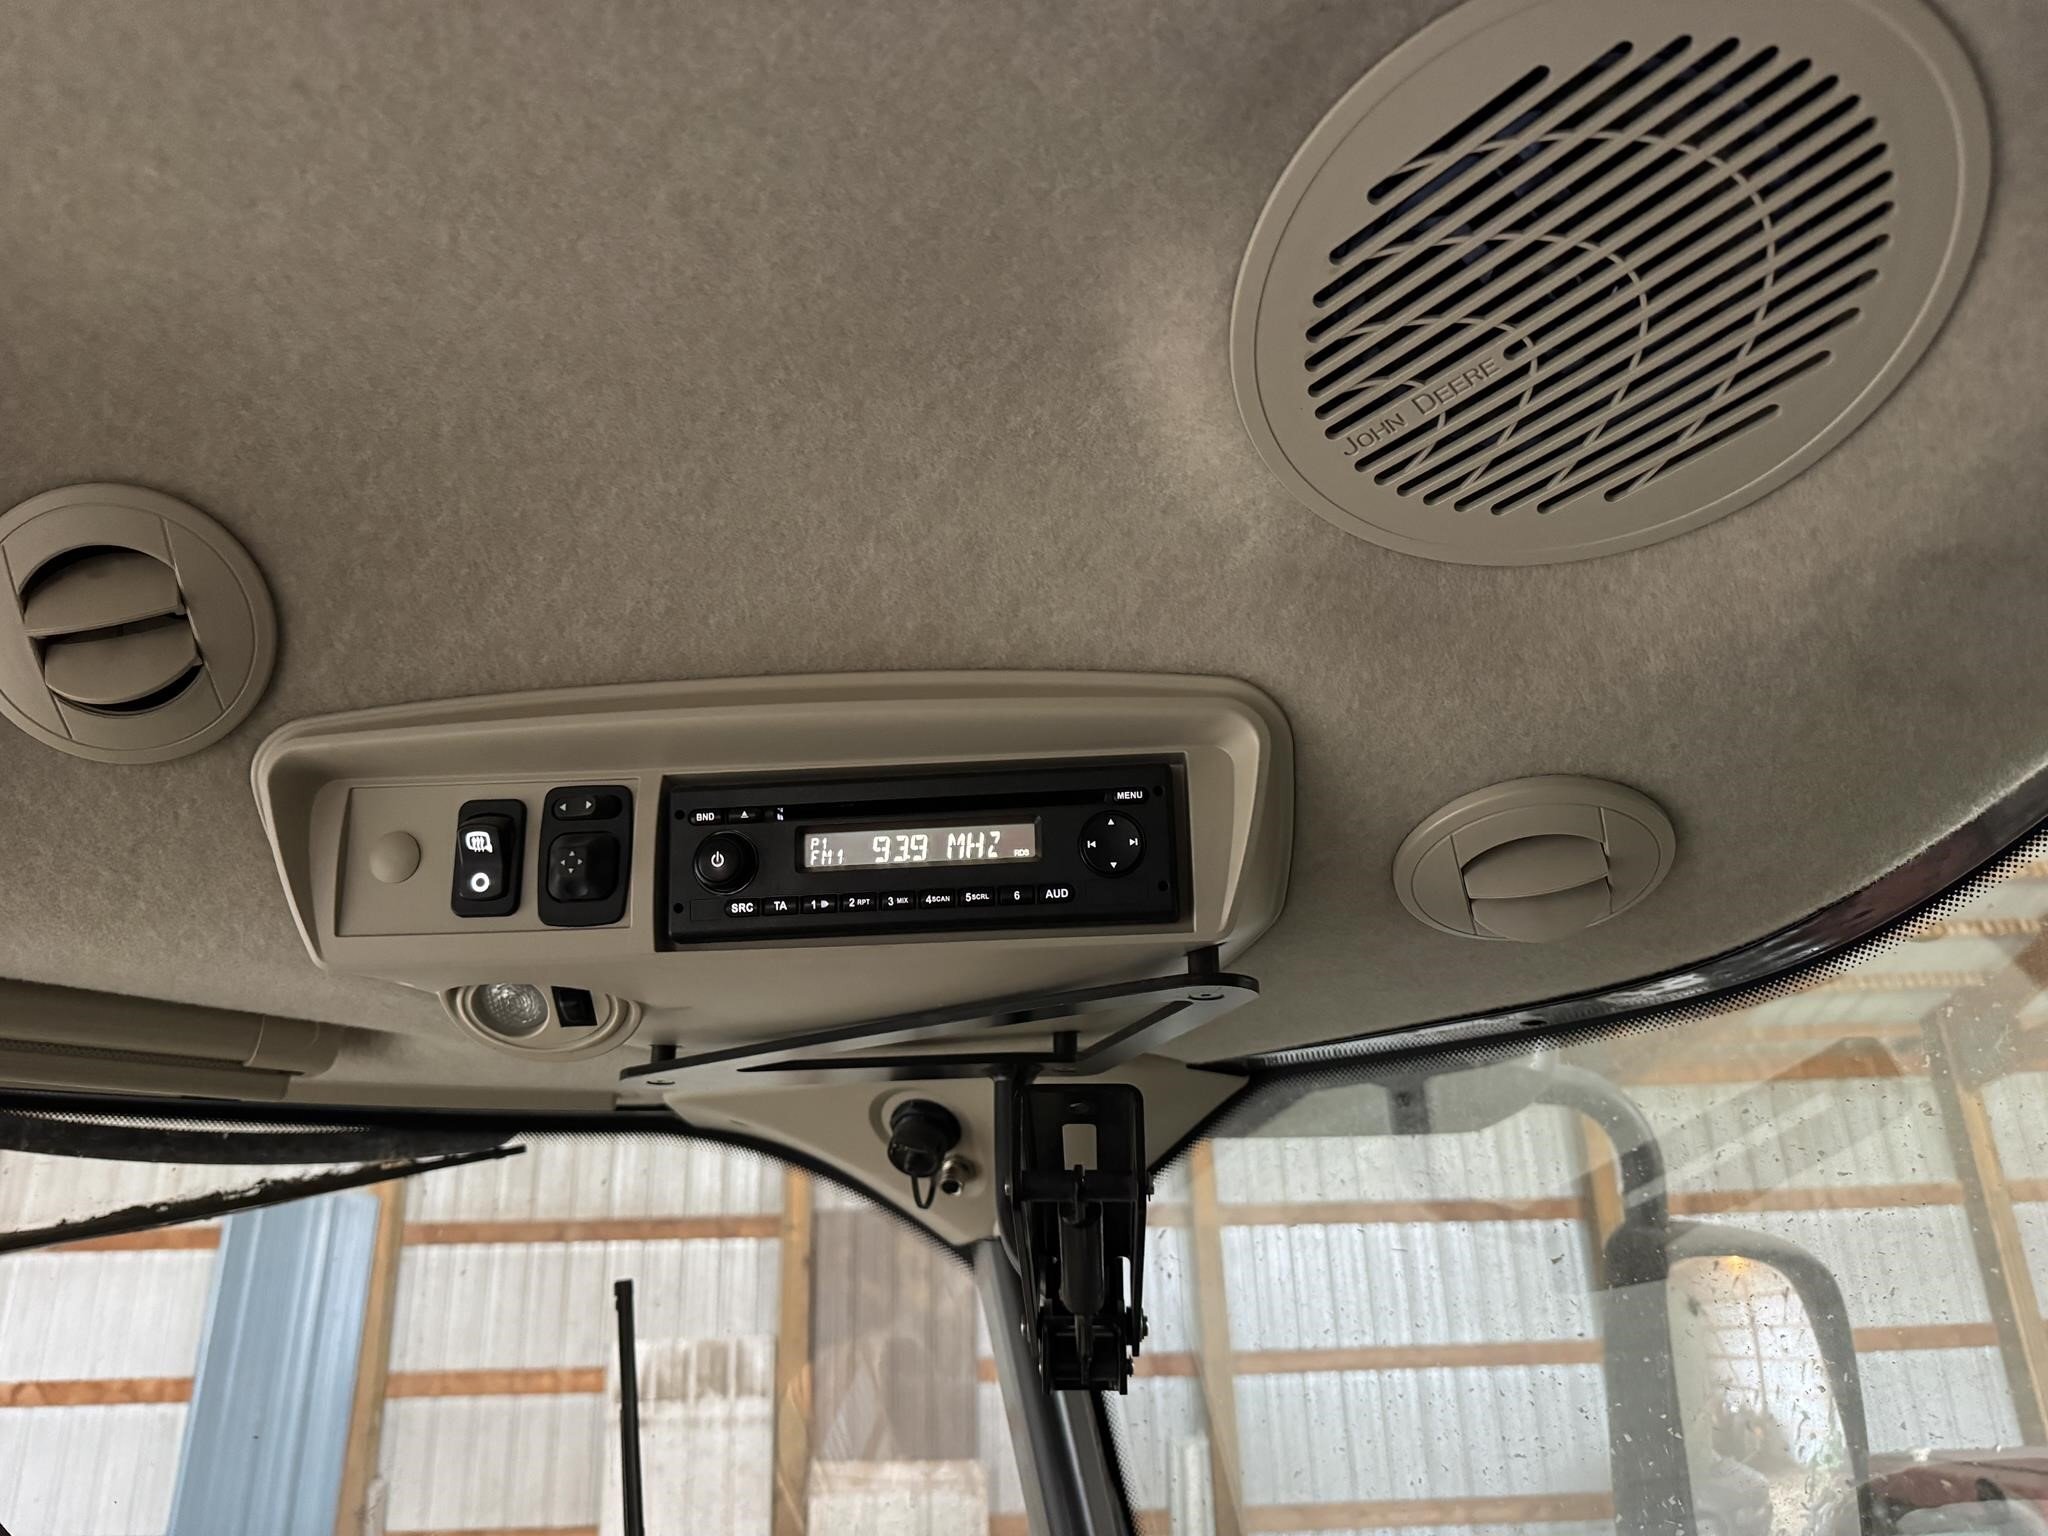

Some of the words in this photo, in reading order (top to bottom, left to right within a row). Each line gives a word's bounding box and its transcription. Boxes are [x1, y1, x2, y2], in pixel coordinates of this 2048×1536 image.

[1343, 412, 1407, 457] JOHN
[1411, 357, 1501, 416] DEERE
[1116, 791, 1143, 800] MENU
[696, 812, 715, 822] BND
[810, 837, 828, 850] P1
[1013, 890, 1021, 900] 6
[1045, 888, 1069, 899] AUD
[773, 901, 788, 911] TA
[811, 900, 816, 910] 1
[848, 897, 856, 908] 2
[857, 898, 871, 906] RPT
[887, 896, 894, 906] 3
[731, 903, 754, 913] SRC
